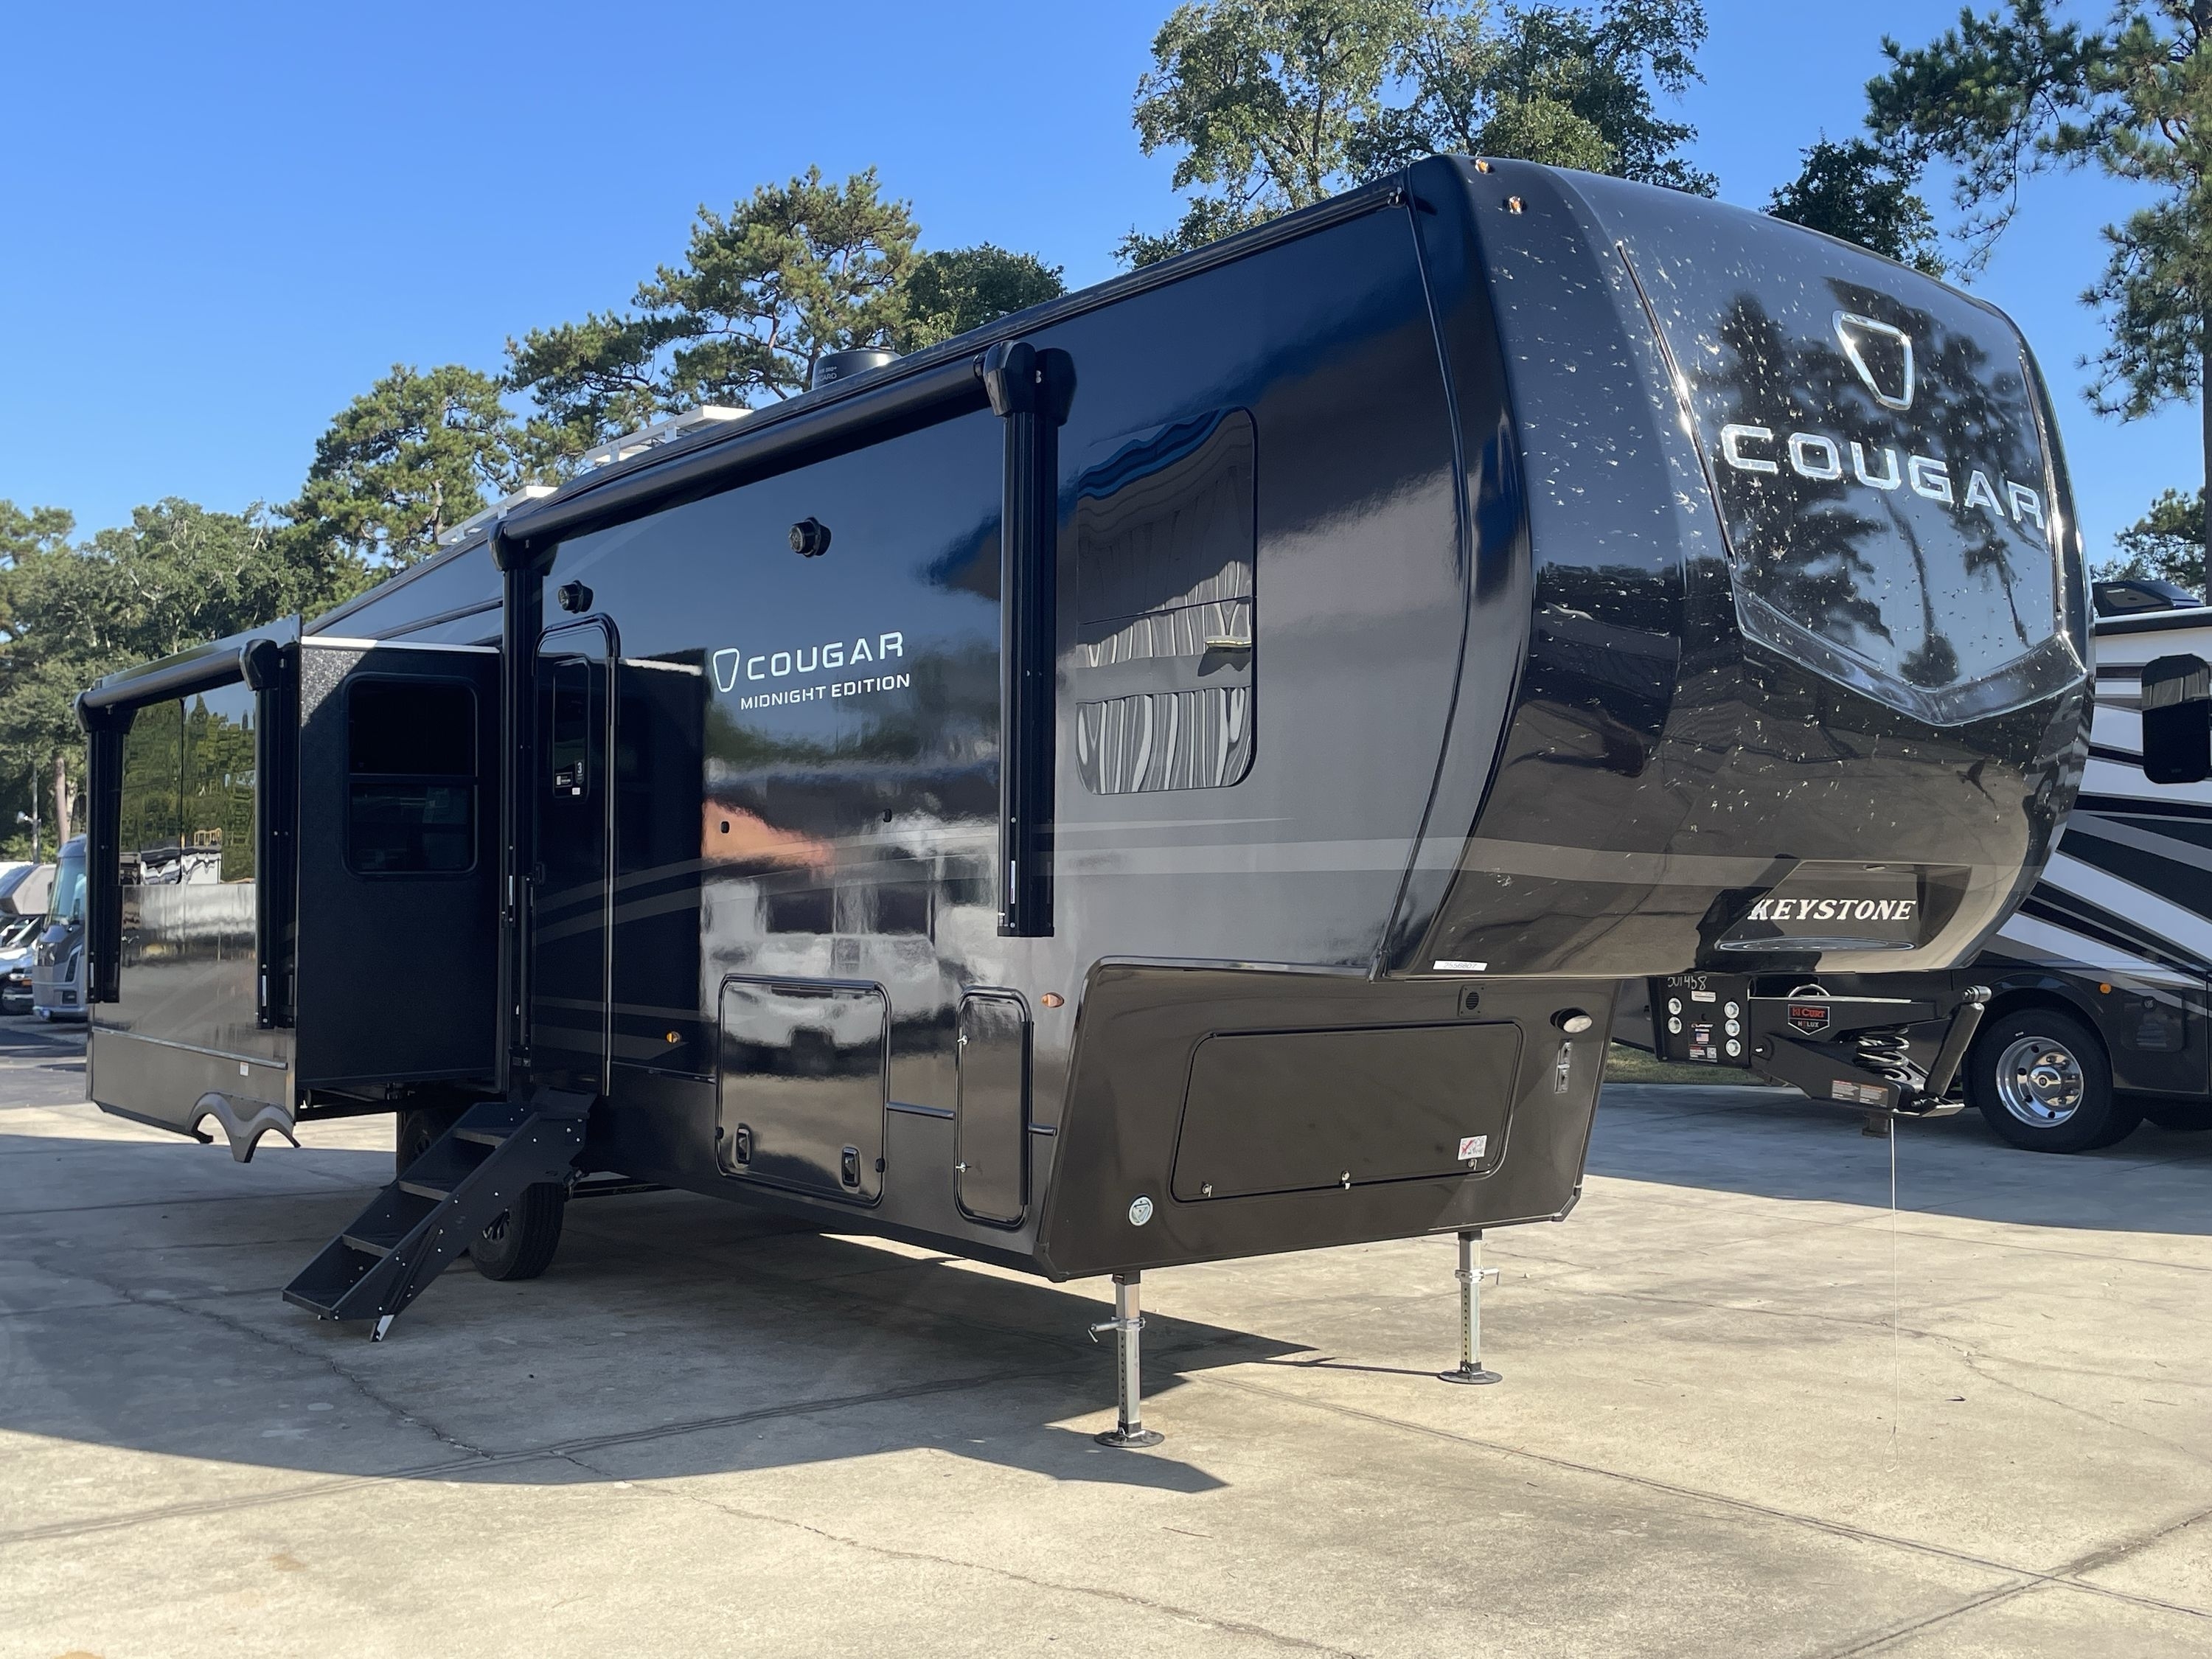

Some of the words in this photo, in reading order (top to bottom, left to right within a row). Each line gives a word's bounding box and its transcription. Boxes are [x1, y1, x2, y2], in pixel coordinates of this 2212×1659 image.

[1720, 423, 2045, 529] COUGAR
[746, 631, 904, 681] COUGAR
[740, 686, 827, 710] MIDNIGHT
[830, 673, 911, 698] EDITION
[1747, 898, 1917, 921] KEYSTONE
[1801, 1008, 1825, 1018] CURT
